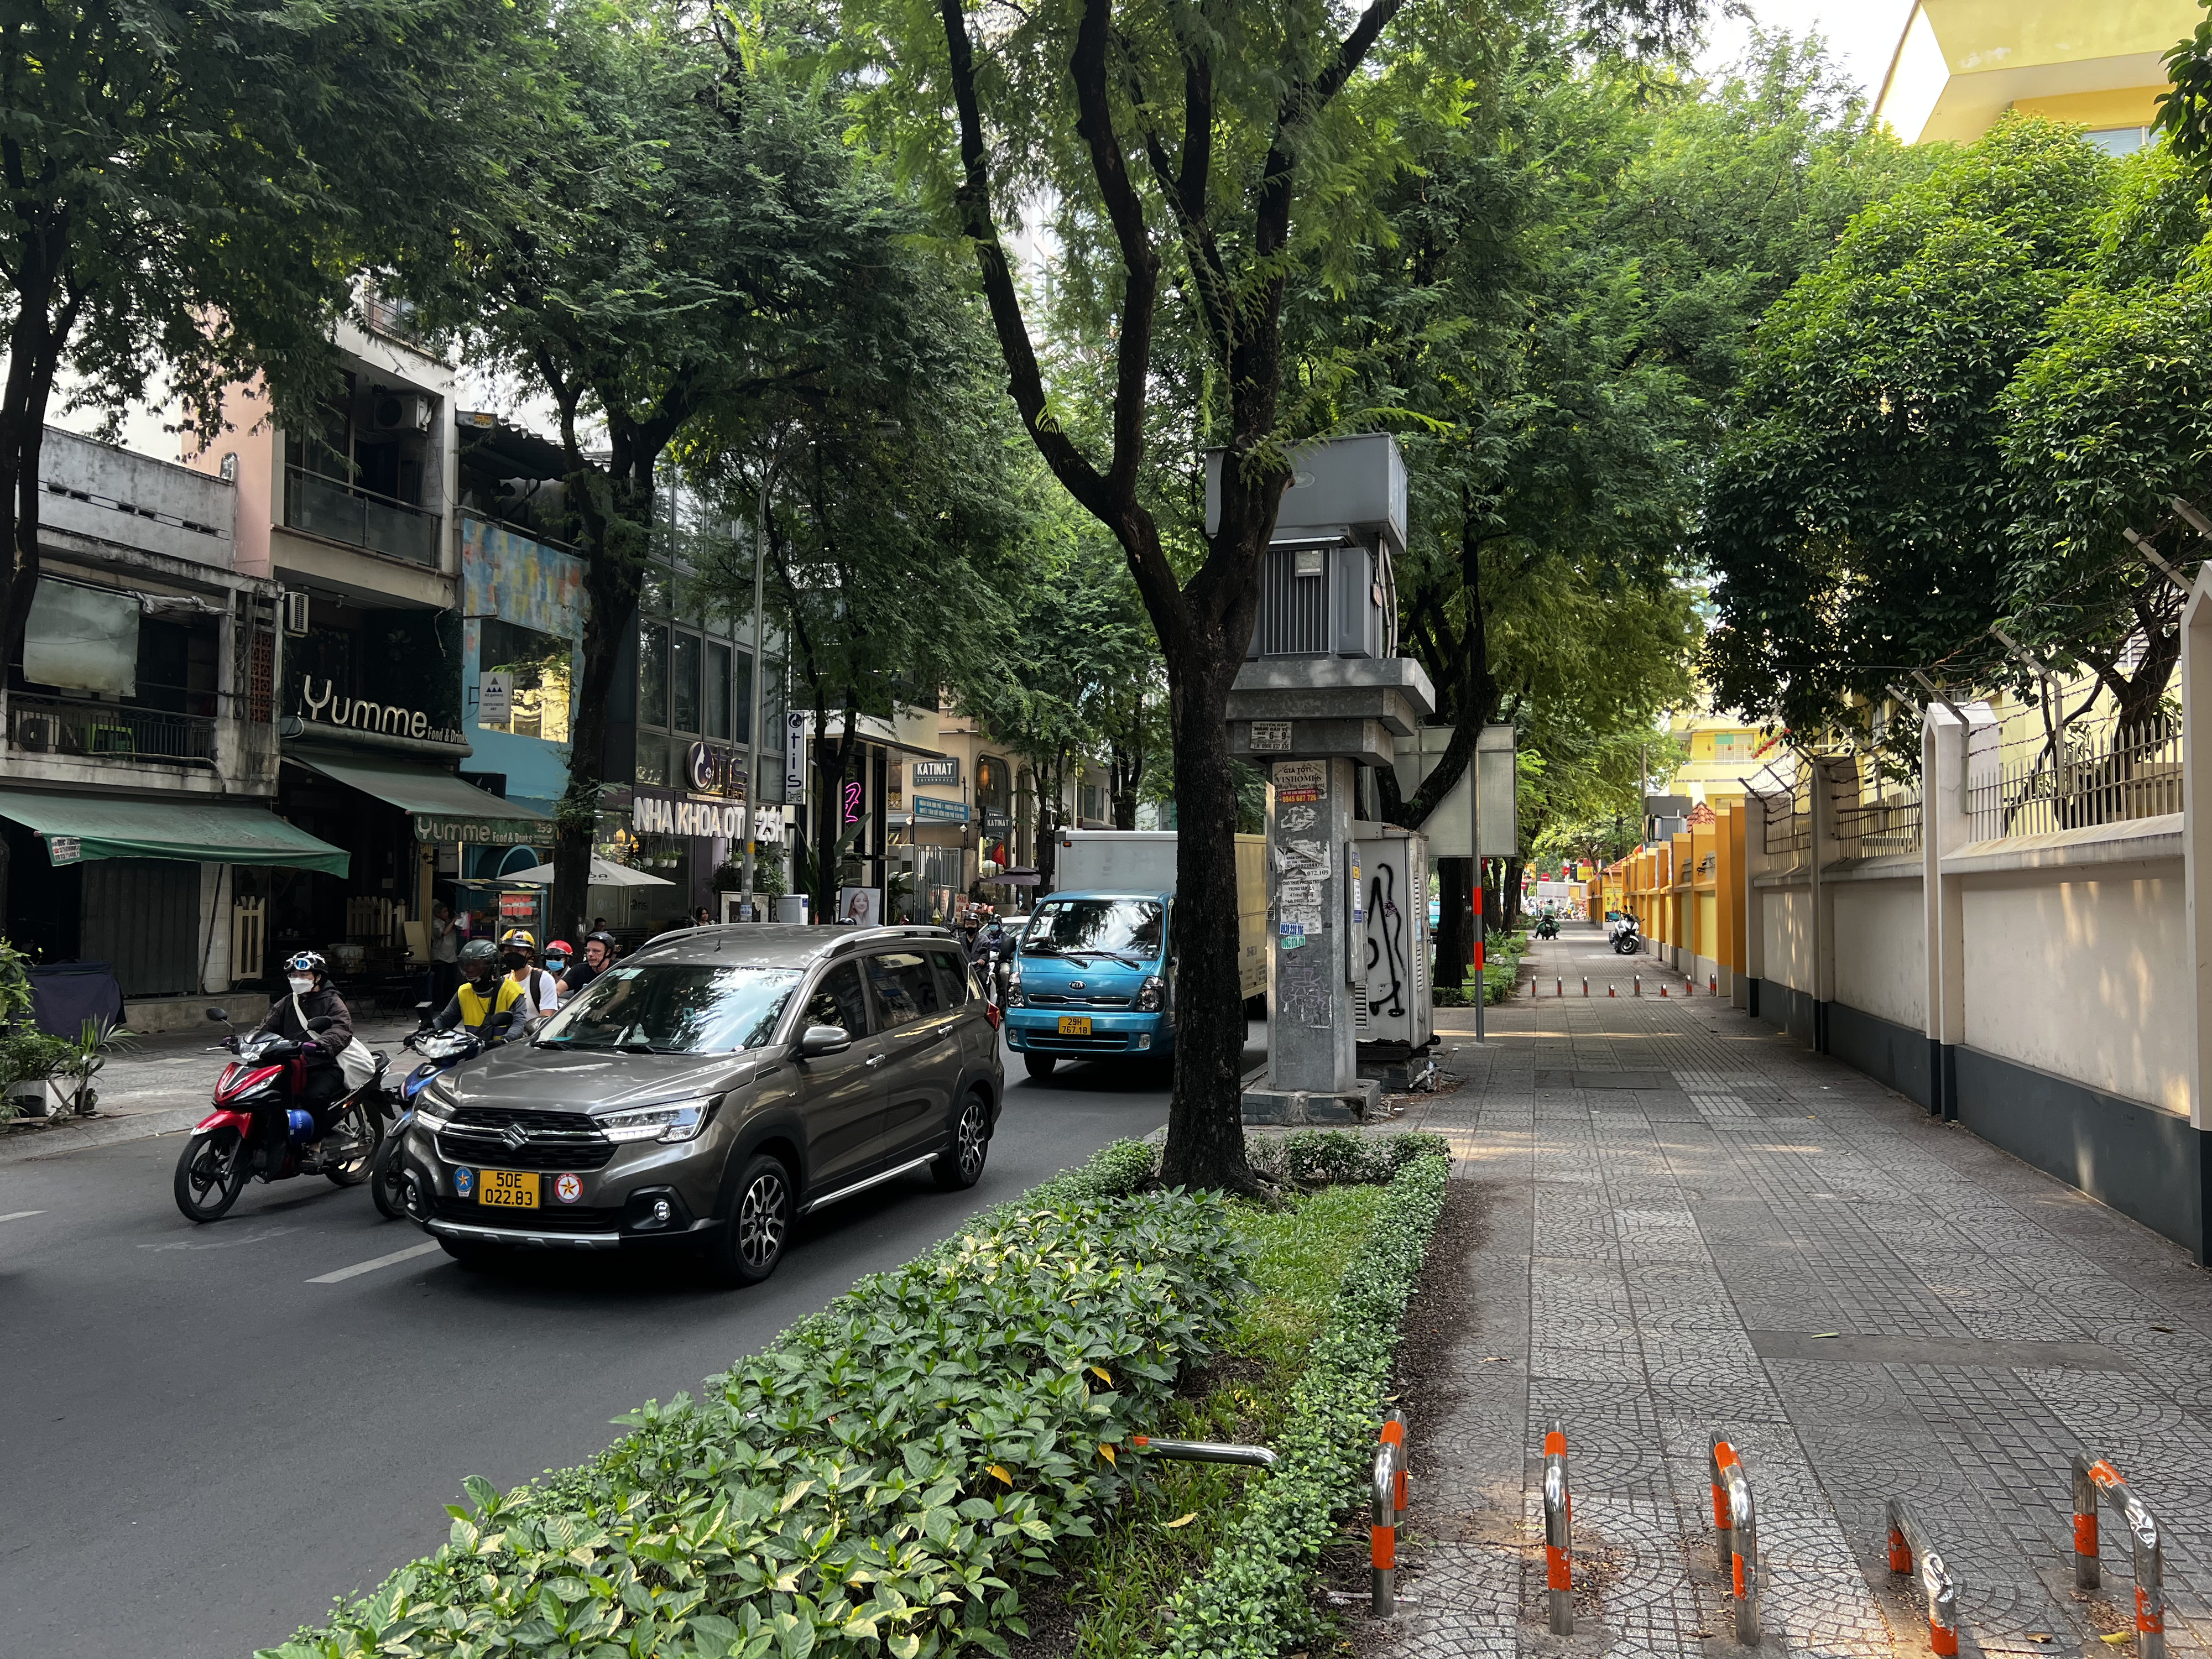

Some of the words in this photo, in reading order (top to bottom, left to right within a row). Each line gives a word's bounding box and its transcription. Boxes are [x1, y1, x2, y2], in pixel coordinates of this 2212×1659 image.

[304, 675, 427, 738] Yumme
[427, 726, 444, 739] Food
[445, 728, 450, 742] &
[450, 729, 468, 744] Drinks
[1281, 732, 1286, 740] 9
[917, 763, 953, 775] KATINAT
[634, 797, 674, 834] NHA
[675, 802, 721, 838] KHOA
[723, 806, 756, 839] OTI
[418, 816, 491, 842] Yumme
[493, 831, 508, 842] Food
[508, 832, 513, 843] &
[515, 832, 533, 843] Drinks
[1062, 1026, 1088, 1034] 767.18
[497, 1172, 523, 1188] 50E
[485, 1188, 533, 1206] 022.83
